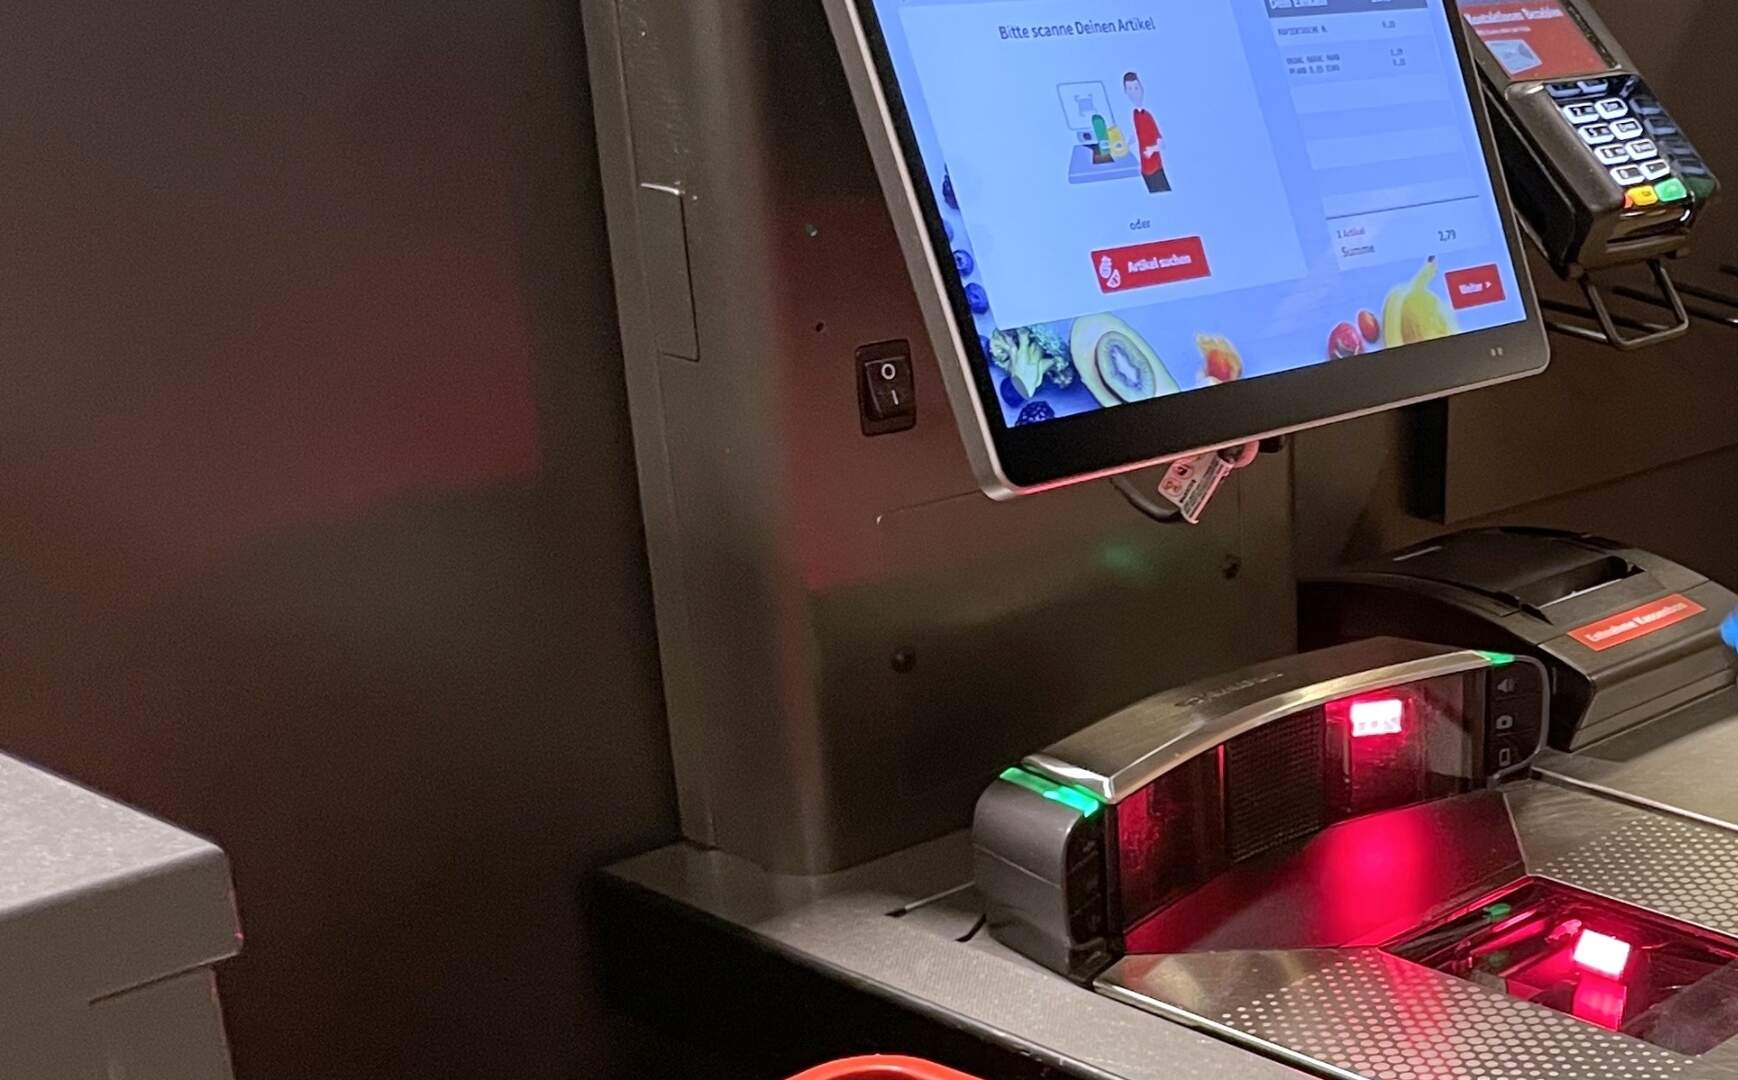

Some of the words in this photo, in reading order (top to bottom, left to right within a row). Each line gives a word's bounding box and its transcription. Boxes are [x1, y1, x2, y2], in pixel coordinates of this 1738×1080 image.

[998, 25, 1030, 40] Bitte
[1031, 23, 1075, 39] scanne
[1075, 19, 1117, 36] Deinen
[1117, 16, 1157, 33] Artikel
[1127, 256, 1160, 274] Artikel
